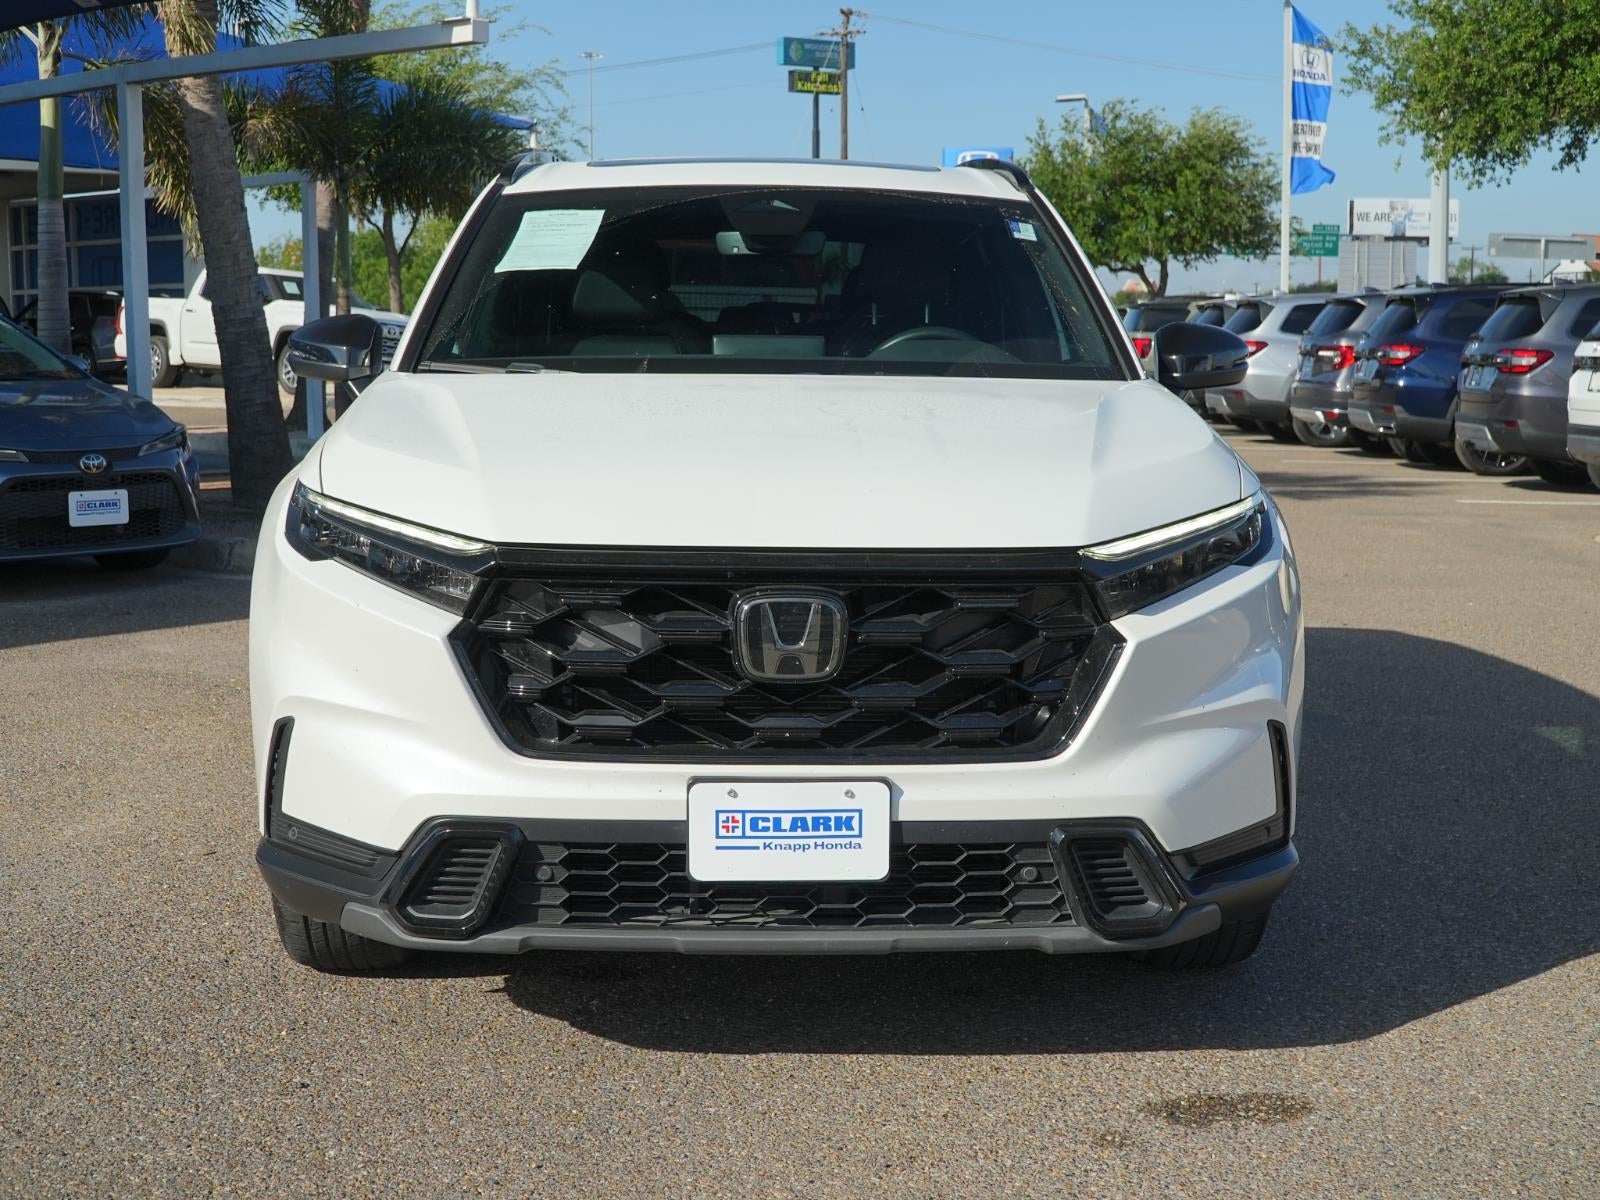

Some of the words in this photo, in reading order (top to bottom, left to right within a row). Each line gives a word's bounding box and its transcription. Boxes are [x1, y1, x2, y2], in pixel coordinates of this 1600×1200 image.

[1293, 69, 1326, 80] HONDA
[1356, 212, 1371, 222] WE
[1373, 212, 1392, 222] ARE
[750, 816, 855, 832] CLARK
[763, 842, 811, 852] Knapp
[814, 840, 862, 850] Honda
